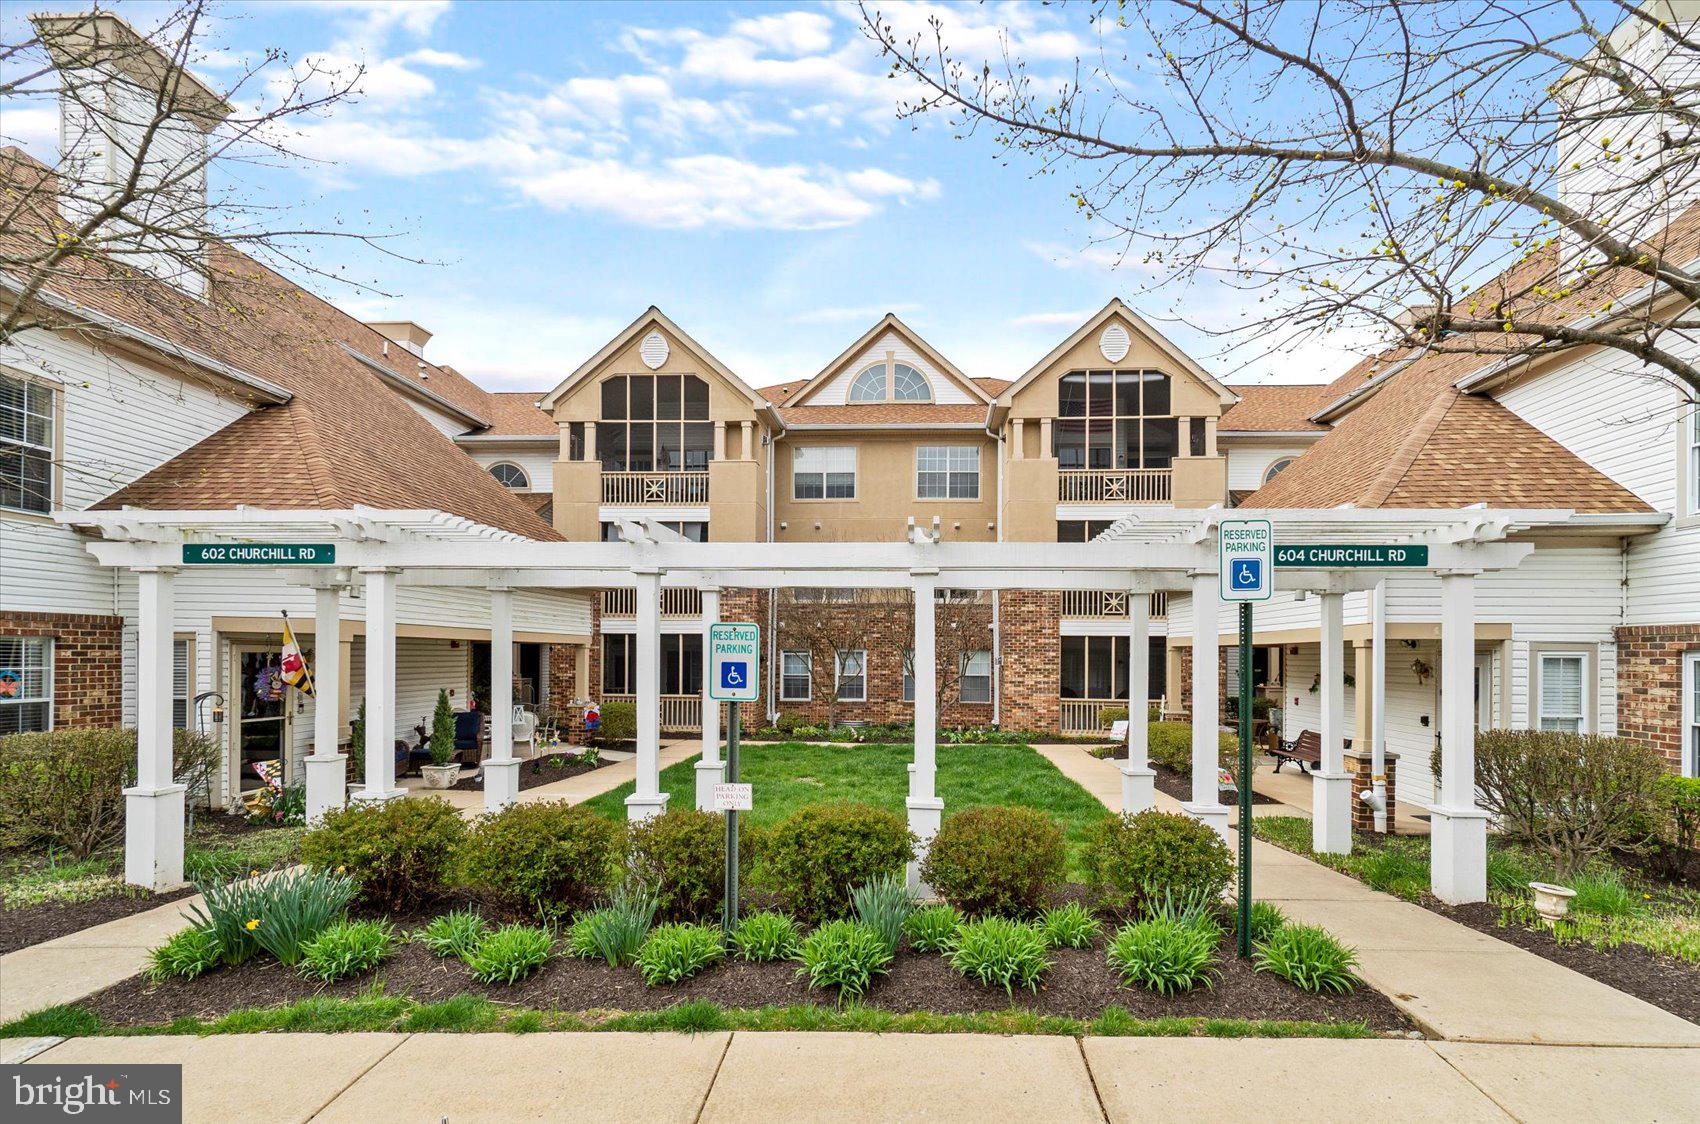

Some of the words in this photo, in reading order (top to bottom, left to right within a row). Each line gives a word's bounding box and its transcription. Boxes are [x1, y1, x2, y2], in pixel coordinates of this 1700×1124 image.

[1224, 530, 1267, 540] RESERVED
[1225, 542, 1266, 552] PARKING
[201, 548, 225, 560] 602
[229, 548, 295, 560] CHURCHILL
[299, 548, 316, 560] RD
[1278, 549, 1305, 562] 604
[1309, 549, 1384, 562] CHURCHILL
[1388, 549, 1406, 562] RD
[713, 631, 755, 641] RESERVED
[715, 644, 753, 654] PARKING
